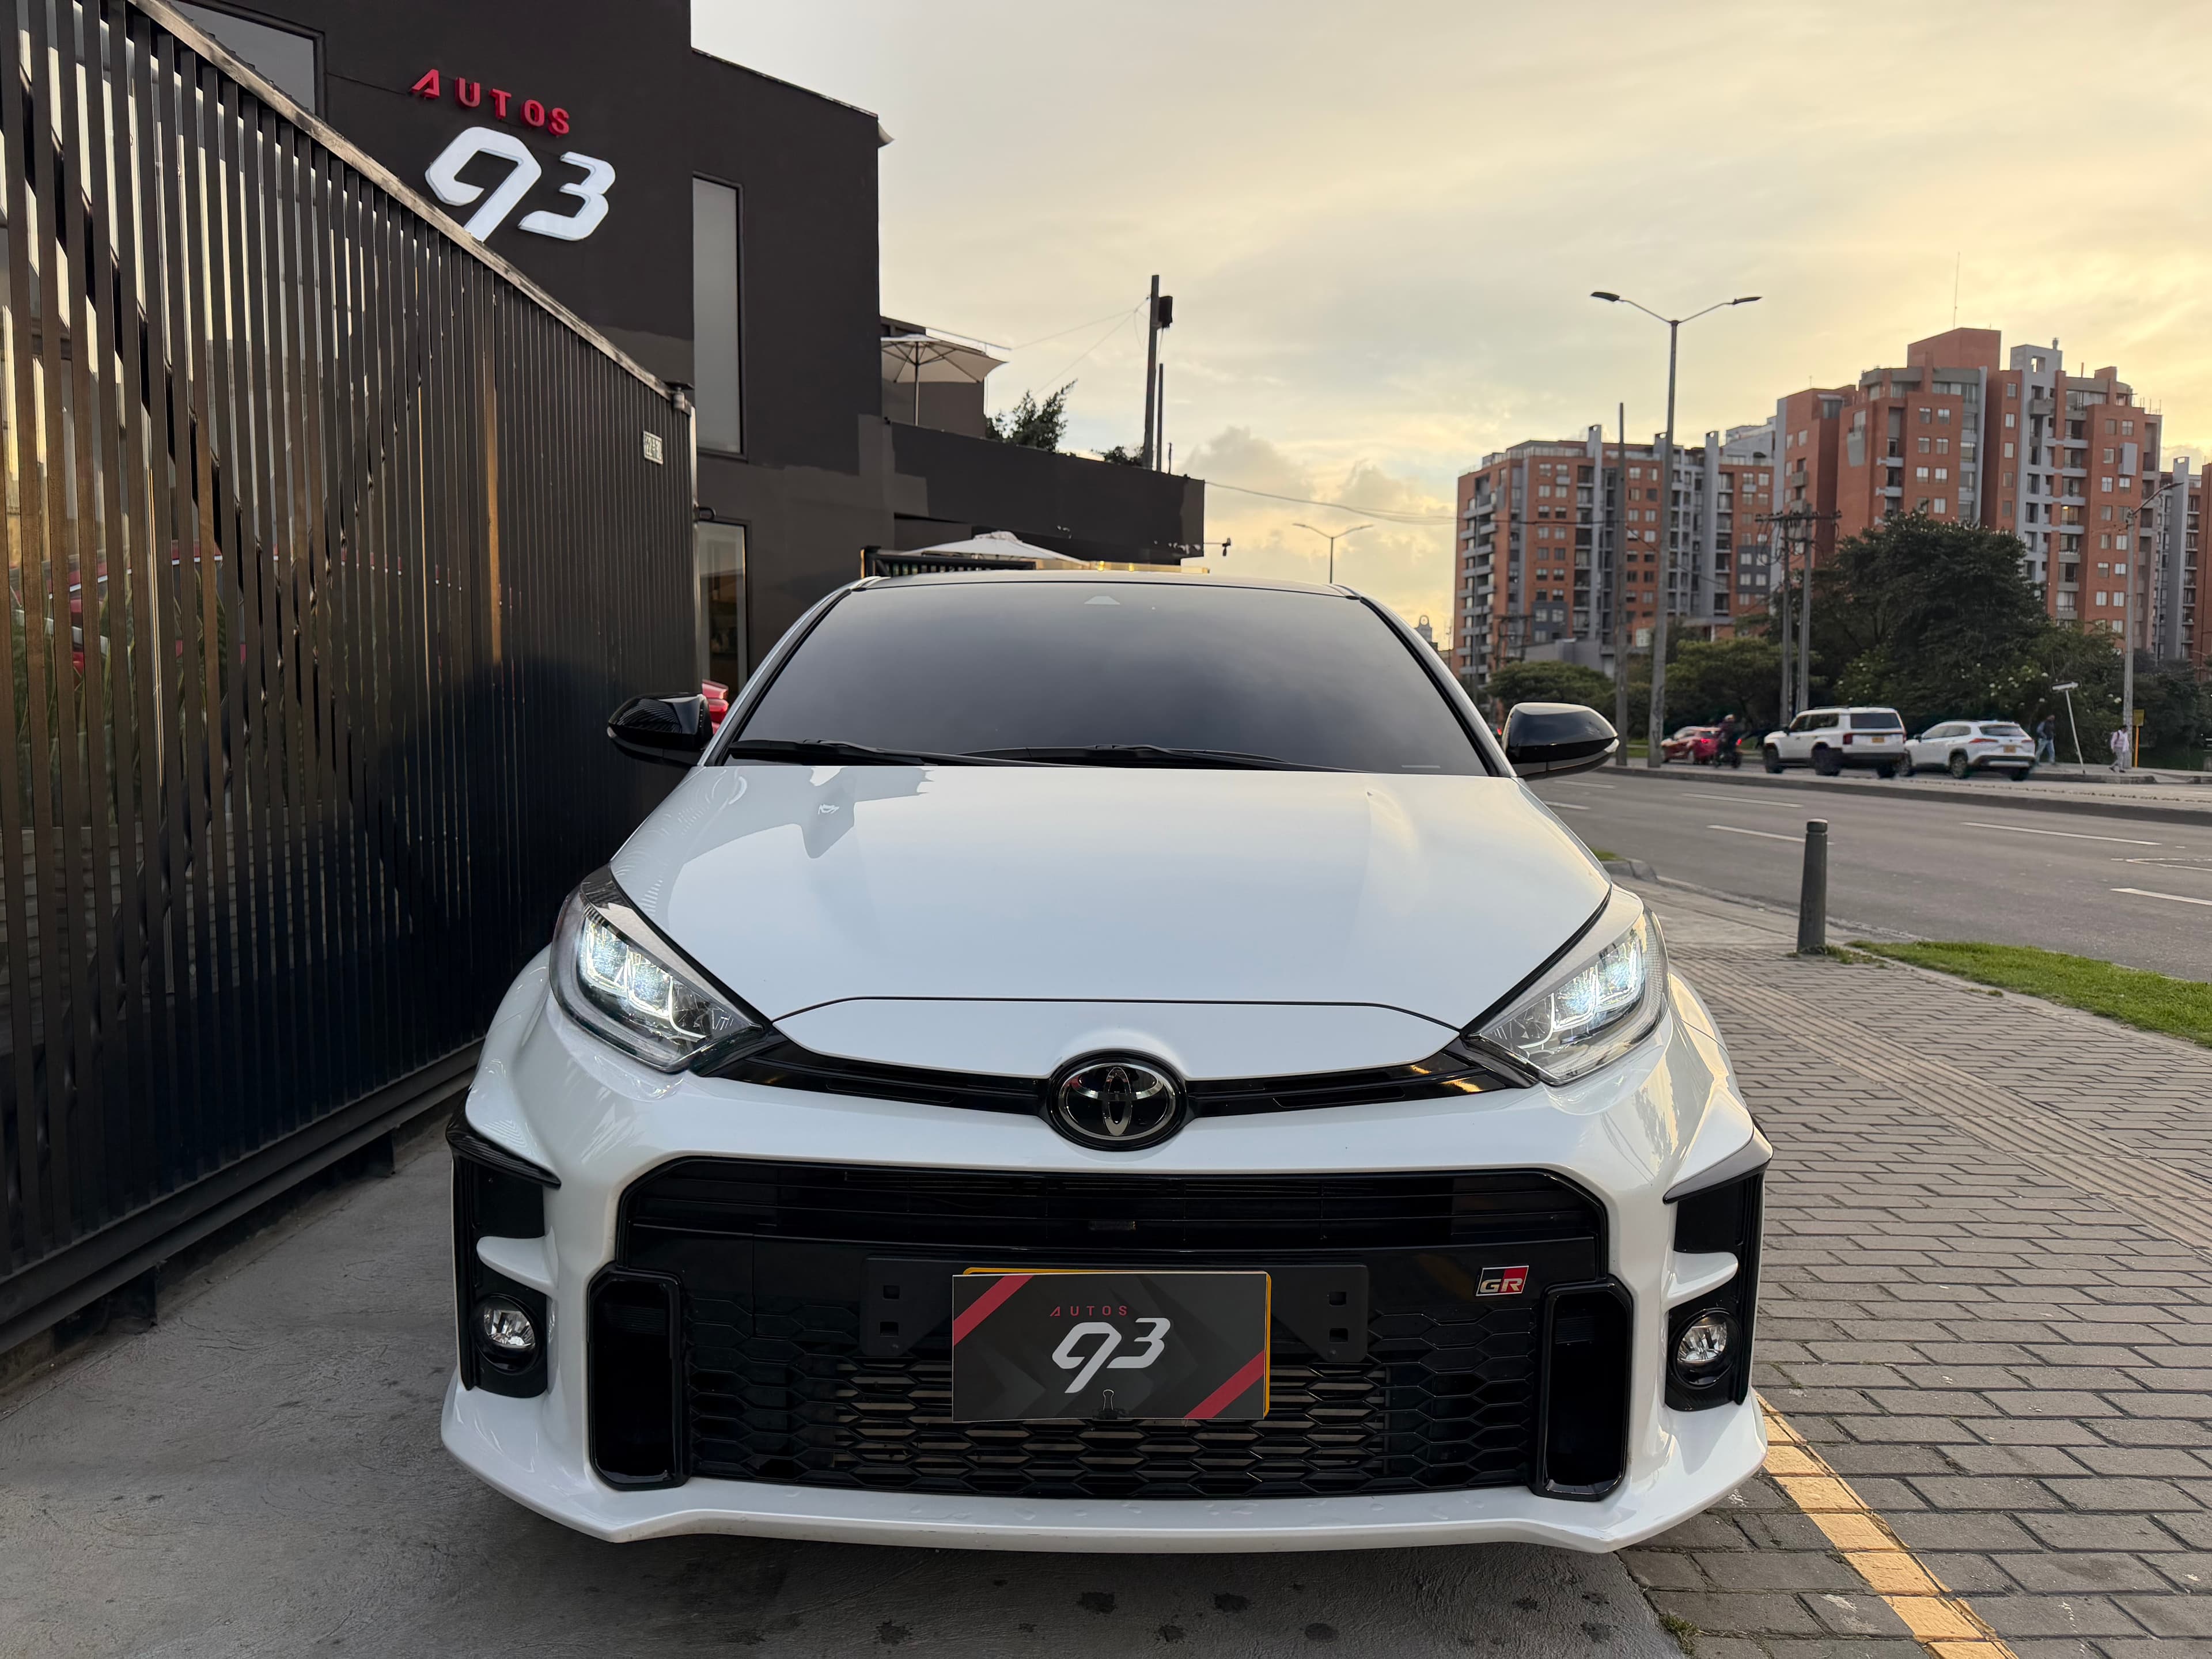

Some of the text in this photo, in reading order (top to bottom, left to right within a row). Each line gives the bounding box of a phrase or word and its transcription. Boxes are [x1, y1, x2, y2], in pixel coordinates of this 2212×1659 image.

[411, 69, 570, 136] AUTOS
[425, 126, 616, 242] 93
[1050, 1305, 1128, 1317] AUTOS
[1480, 1278, 1523, 1293] GR
[1052, 1317, 1171, 1393] 93
